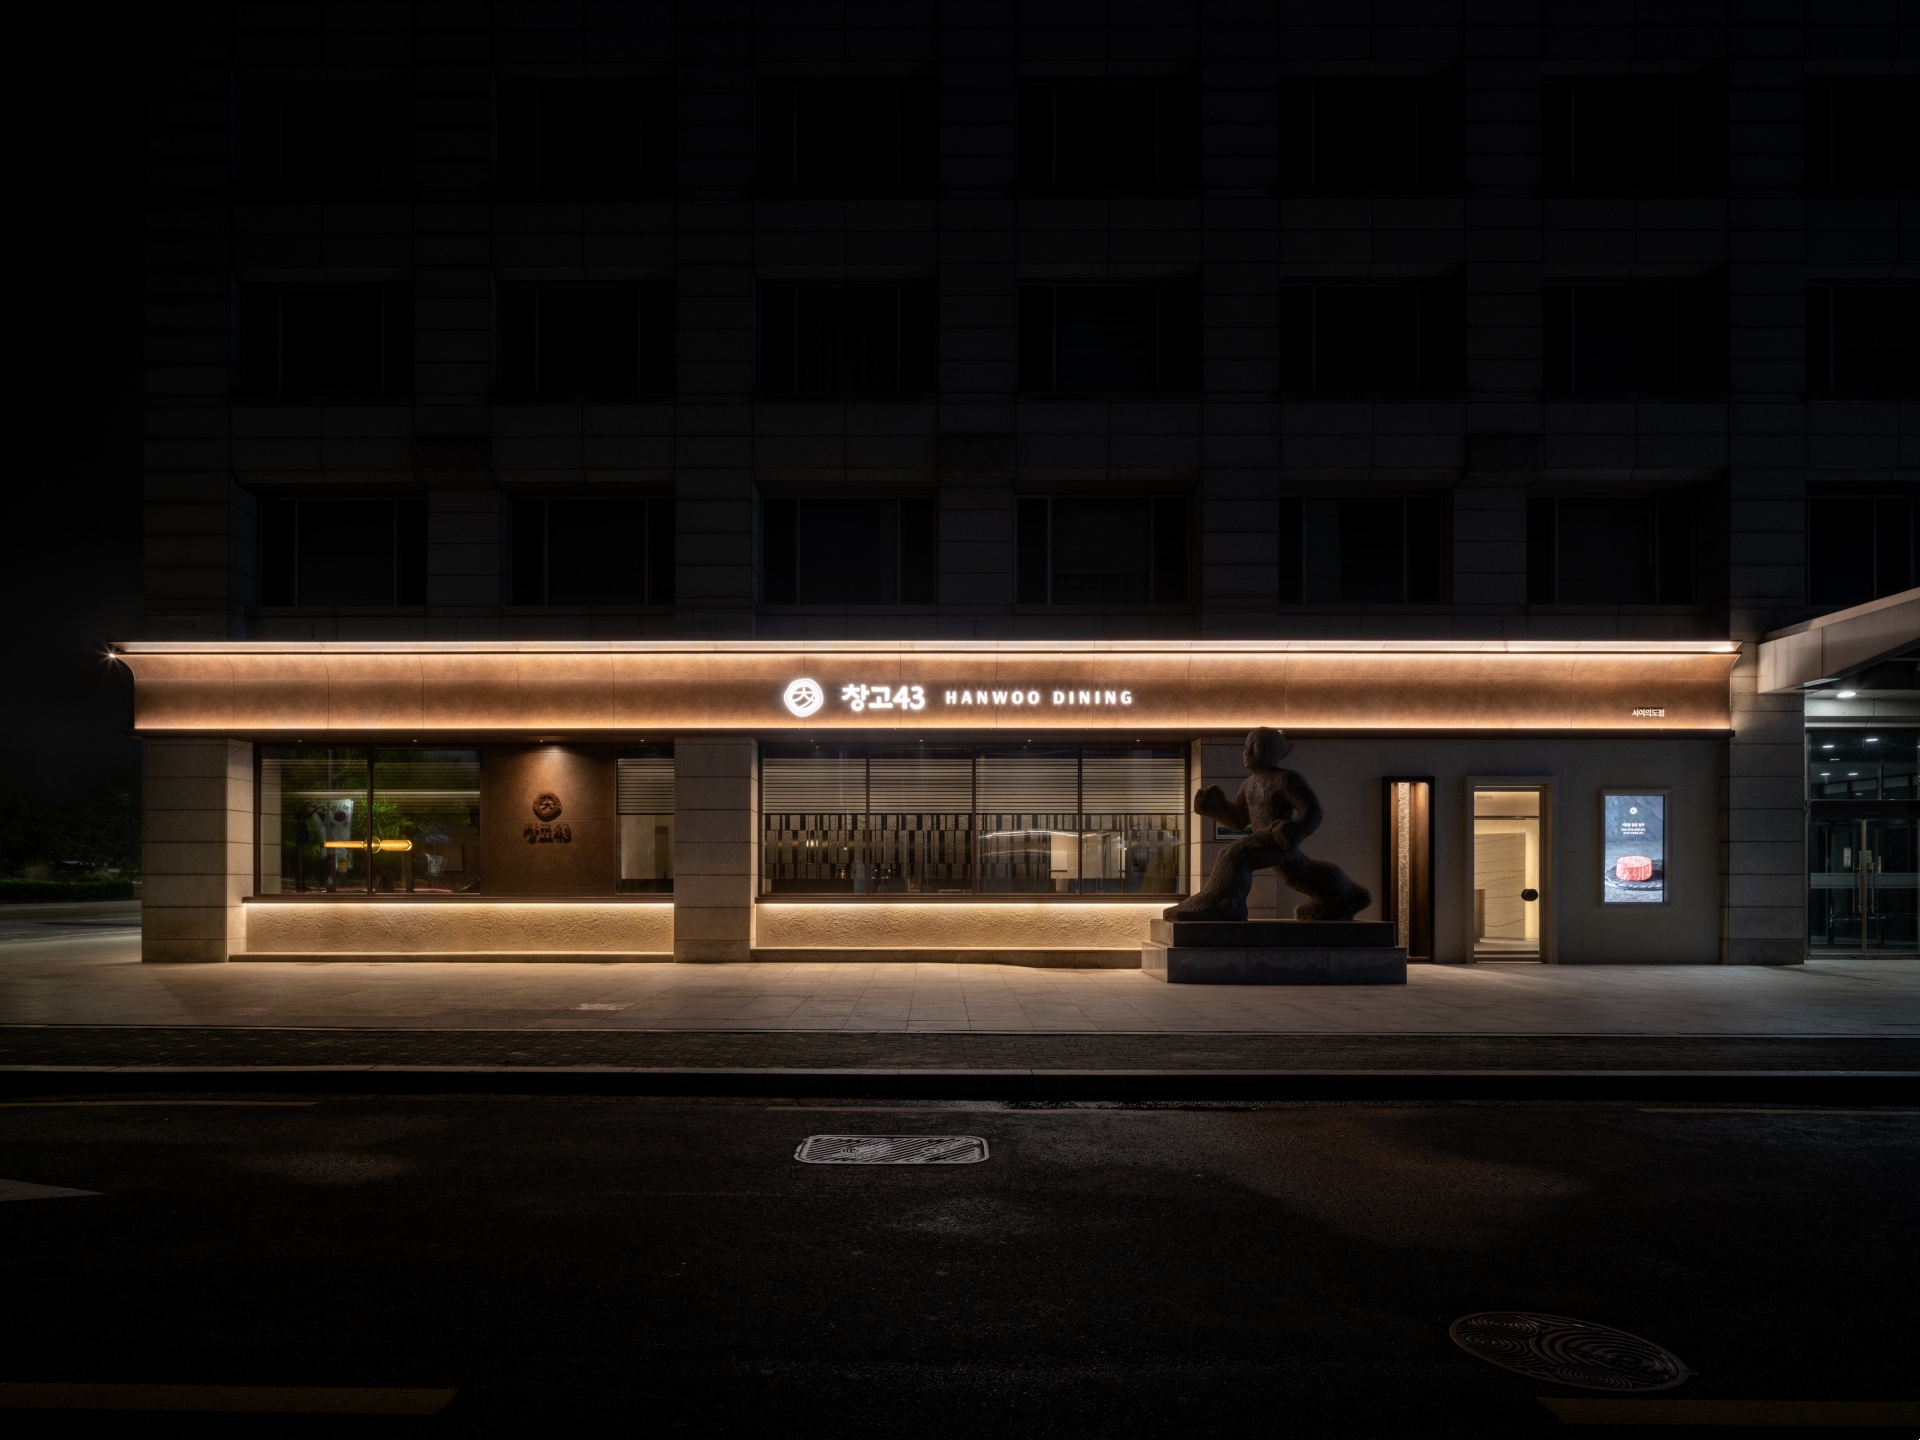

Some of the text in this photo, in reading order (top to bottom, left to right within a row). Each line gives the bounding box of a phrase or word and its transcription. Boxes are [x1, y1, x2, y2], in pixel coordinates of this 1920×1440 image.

[841, 684, 925, 711] 창고43
[945, 690, 1133, 705] HANWOO DINING
[1632, 708, 1665, 717] 서여의도점
[523, 822, 572, 844] 창고43
